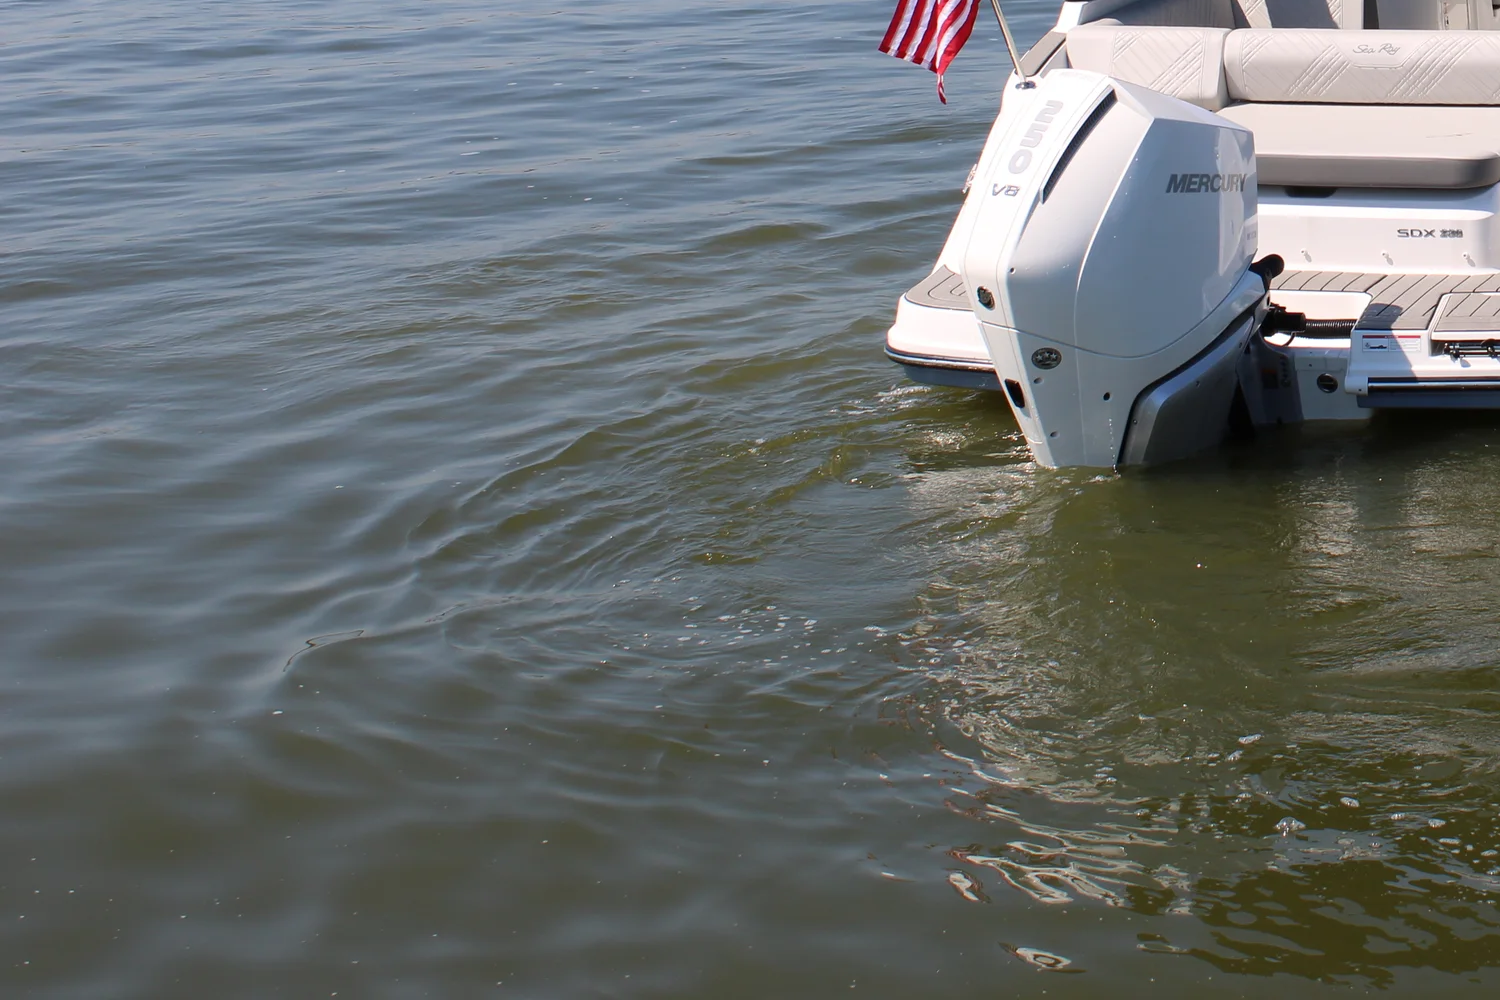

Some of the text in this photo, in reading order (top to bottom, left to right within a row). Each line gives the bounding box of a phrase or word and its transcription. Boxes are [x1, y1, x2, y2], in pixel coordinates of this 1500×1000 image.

[1352, 42, 1401, 56] Sea Ray
[1007, 99, 1064, 175] 250
[991, 183, 1020, 197] V8
[1165, 173, 1247, 194] MERCURY
[1396, 228, 1436, 239] SDX
